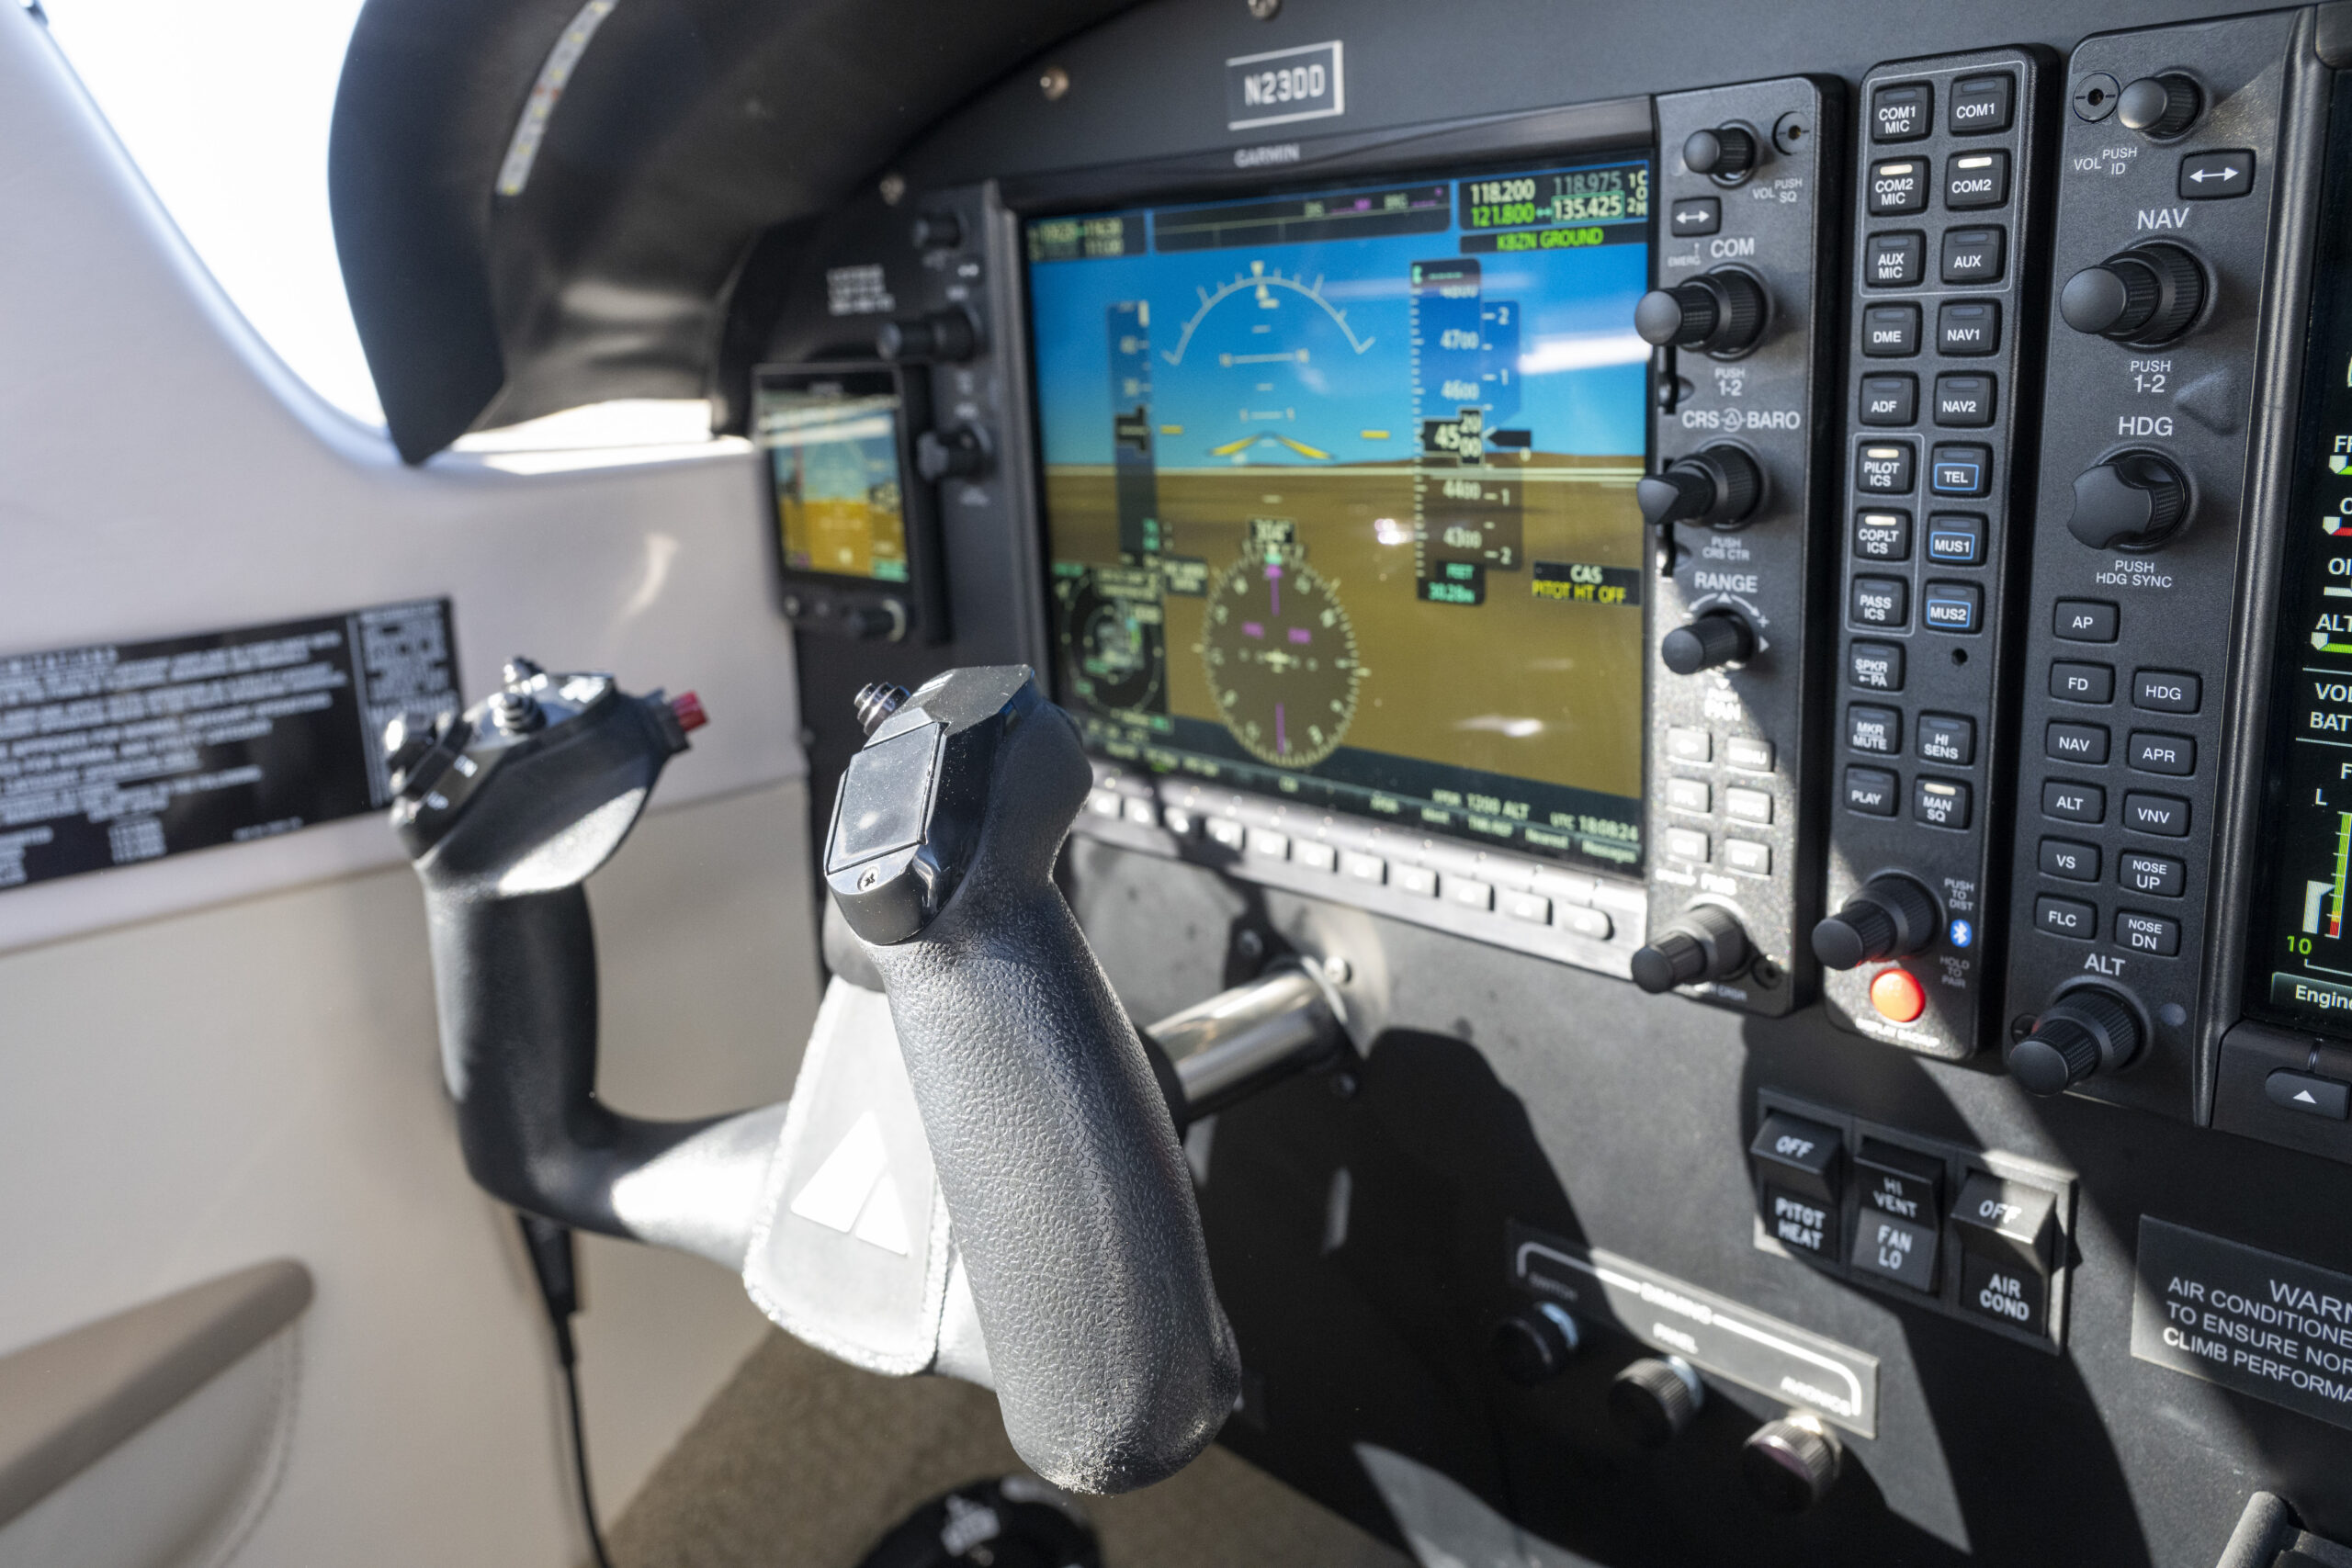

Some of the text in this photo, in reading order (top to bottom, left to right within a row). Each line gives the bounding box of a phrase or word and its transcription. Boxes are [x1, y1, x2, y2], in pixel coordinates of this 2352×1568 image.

[1244, 63, 1325, 107] N2300
[1878, 105, 1917, 122] COM1
[1956, 103, 1996, 118] COM1
[1884, 120, 1911, 133] MIC
[2102, 147, 2138, 160] PUSH
[2074, 157, 2102, 171] VOL
[2111, 163, 2126, 175] ID
[1774, 177, 1803, 190] PUSH
[1875, 178, 1914, 194] COM2
[1951, 178, 1993, 194] COM2
[1471, 178, 1536, 206] 118.200
[1753, 186, 1776, 199] VOL
[1780, 190, 1797, 203] SQ
[1881, 193, 1906, 206] MIC
[1554, 195, 1623, 221] 135.425
[2137, 207, 2190, 230] NAV
[1539, 226, 1604, 249] GROUND
[1710, 237, 1755, 258] COM
[1877, 254, 1905, 266] AUX
[1953, 254, 1983, 269] AUX
[1878, 265, 1904, 279] MIC
[1872, 330, 1902, 344] DME
[1947, 328, 1981, 342] NAV1
[1715, 367, 1744, 379] PUSH
[2130, 360, 2172, 373] PUSH
[1717, 379, 1743, 396] 1-2
[2133, 375, 2165, 393] 1-2
[1871, 400, 1897, 413] ADF
[1942, 400, 1976, 412] NAV2
[1681, 411, 1801, 430] CRS BARO
[2118, 416, 2174, 436] HDG
[1863, 461, 1900, 474] PILOT
[1870, 474, 1891, 487] ICS
[1944, 469, 1968, 484] TEL
[1712, 536, 1742, 548] PUSH
[1858, 529, 1899, 542] COPLT
[1867, 541, 1888, 555] ICS
[1934, 538, 1971, 553] MUS1
[2114, 559, 2155, 573] PUSH
[1570, 564, 1603, 584] CAS
[1694, 570, 1758, 593] RANGE
[2096, 572, 2173, 589] HDG SYNC
[1532, 579, 1626, 604] PITOT HT OFF
[1859, 594, 1892, 609] PASS
[1864, 607, 1885, 621] ICS
[1930, 607, 1967, 621] MUS2
[2072, 615, 2094, 629] AP
[1855, 659, 1888, 673] SPKR
[1871, 674, 1887, 687] PA
[2068, 677, 2088, 691] FD
[2145, 685, 2181, 700] HDG
[1856, 721, 1884, 735] MKR
[1852, 735, 1887, 750] MUTE
[1934, 733, 1949, 746] HI
[2059, 737, 2090, 751] NAV
[1924, 743, 1959, 760] SENS
[2143, 748, 2176, 762] APR
[1851, 789, 1882, 806] PLAY
[1922, 795, 1952, 812] MAN
[2056, 795, 2084, 811] ALT
[2315, 788, 2327, 806] L
[1926, 809, 1947, 823] SQ
[2137, 807, 2170, 824] VNV
[2056, 854, 2076, 869] VS
[2132, 860, 2167, 874] NOSE
[1944, 877, 1974, 892] PUSH
[2136, 874, 2161, 890] UP
[1951, 889, 1967, 900] TO
[1949, 898, 1974, 912] DIST
[2048, 910, 2076, 928] FLC
[2128, 919, 2163, 935] NOSE
[2132, 933, 2157, 951] DN
[2287, 935, 2312, 955] 10
[1939, 954, 1970, 970] HOLD
[2084, 953, 2126, 976] ALT
[1948, 966, 1963, 978] TO
[1941, 975, 1966, 988] PAIR
[1775, 1135, 1814, 1157] OFF
[1883, 1177, 1903, 1196] HI
[1872, 1189, 1918, 1218] VENT
[1775, 1197, 1826, 1229] PITOT
[1978, 1199, 2022, 1224] OFF
[1778, 1219, 1824, 1250] HEAT
[1877, 1224, 1913, 1253] FAN
[1878, 1247, 1903, 1270] LO
[1988, 1272, 2021, 1299] AIR
[2168, 1276, 2205, 1303] AIR
[1979, 1288, 2030, 1321] COND
[2166, 1300, 2197, 1325] TO
[2202, 1312, 2299, 1359] ENSURE
[2163, 1326, 2228, 1362] CLIMB
